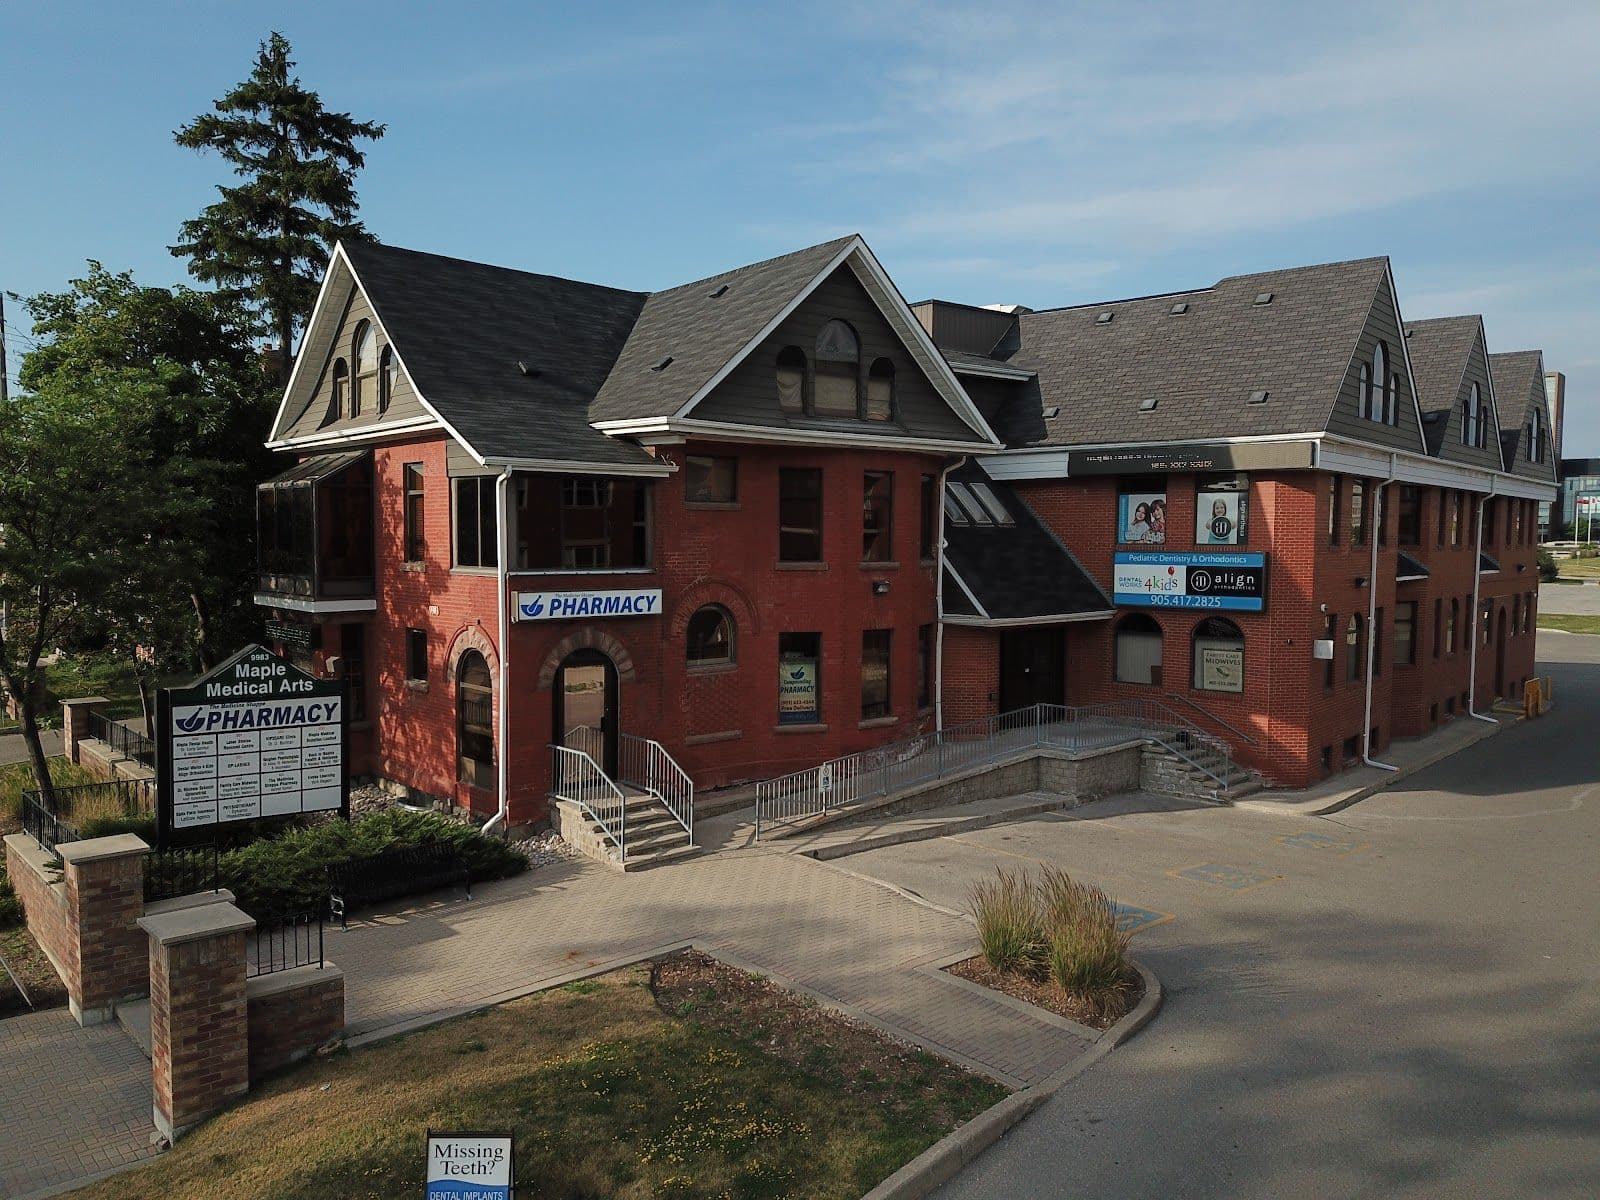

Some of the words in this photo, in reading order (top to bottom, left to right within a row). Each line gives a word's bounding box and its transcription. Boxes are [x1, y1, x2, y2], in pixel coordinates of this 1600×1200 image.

[1159, 555, 1190, 563] Dentistry
[1214, 573, 1254, 586] align
[549, 595, 657, 616] PHARMACY
[1151, 595, 1221, 607] 905.417.2825
[235, 663, 286, 680] Maple
[206, 682, 273, 697] Medical
[279, 679, 314, 692] Arts
[206, 702, 339, 731] PHARMACY
[434, 1144, 504, 1162] Missing
[440, 1160, 495, 1175] Teeth?
[430, 1191, 460, 1200] DENTAL
[463, 1191, 503, 1200] IMPLANTS
